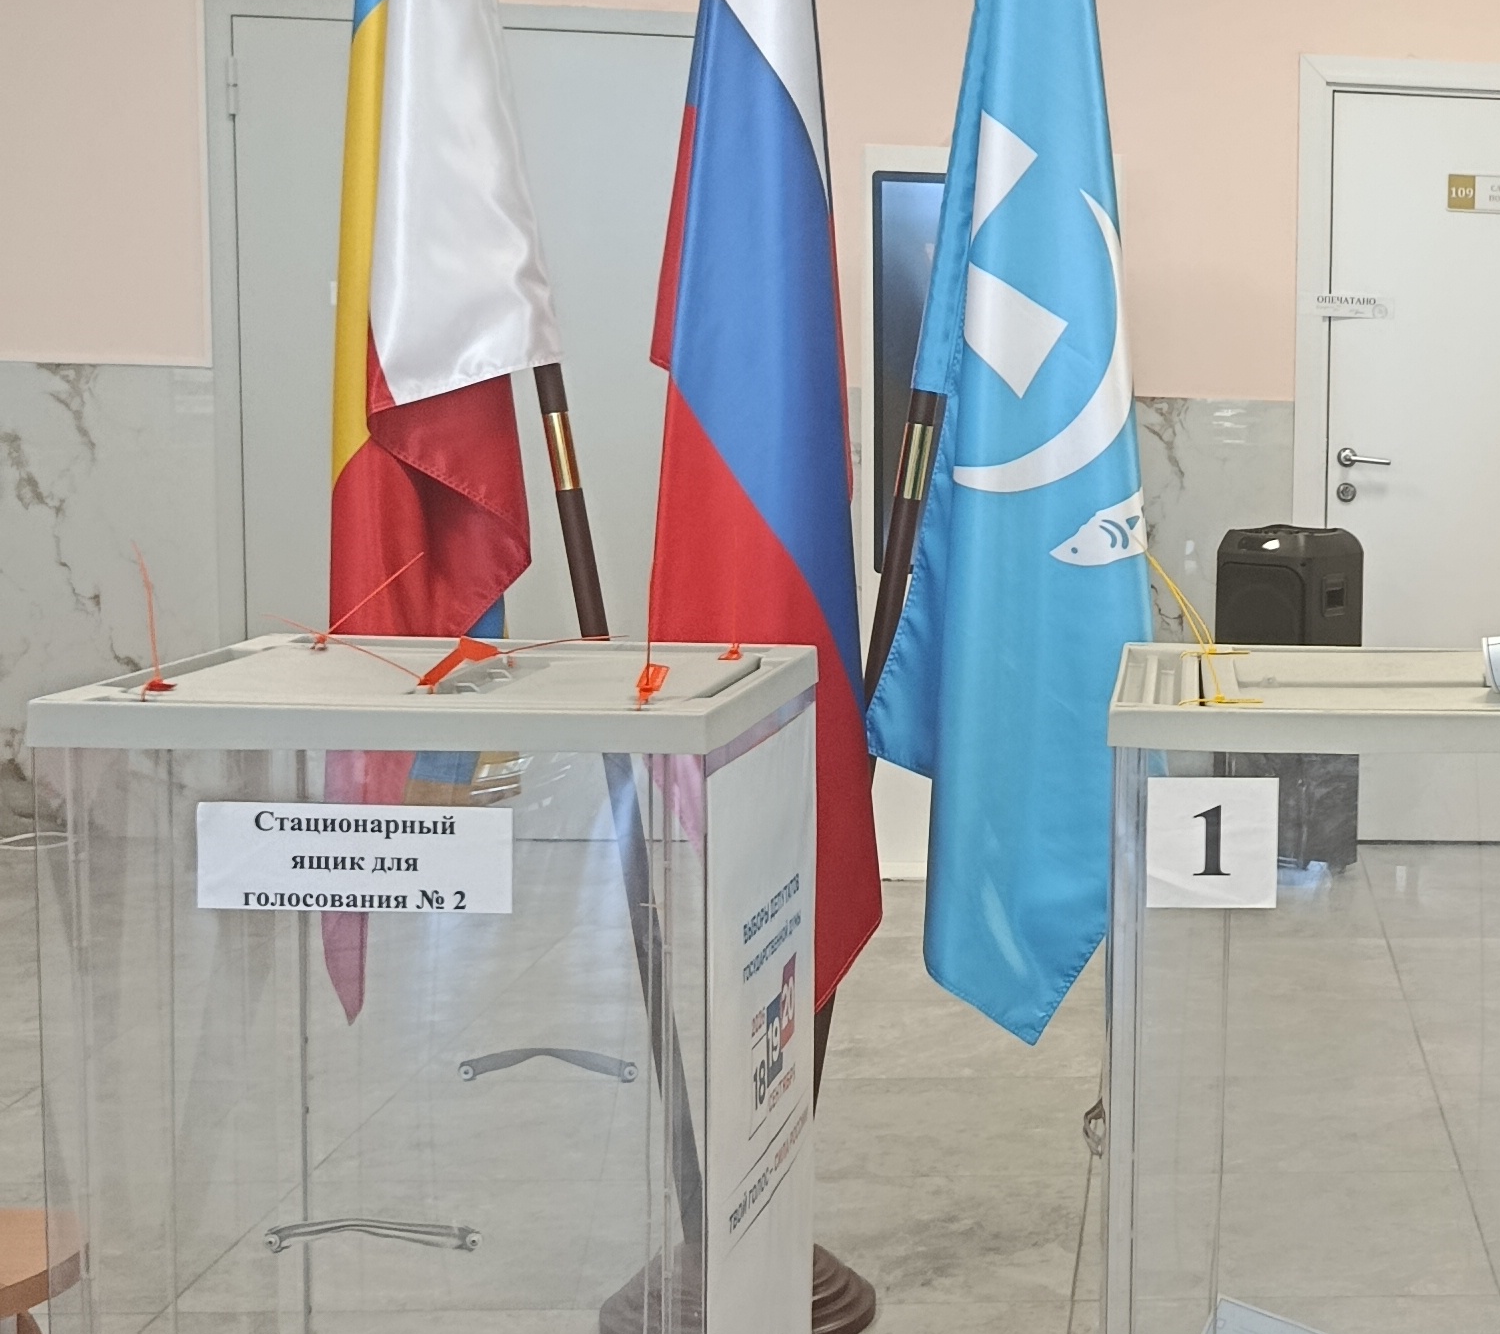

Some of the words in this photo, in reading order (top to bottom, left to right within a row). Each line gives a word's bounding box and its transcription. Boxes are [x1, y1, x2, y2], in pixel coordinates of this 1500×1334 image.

[1450, 187, 1474, 199] 109
[1316, 295, 1377, 306] ОПЕЧАТАНО
[254, 810, 456, 839] Стационарный
[1192, 804, 1232, 877] 1
[291, 854, 366, 872] ящик
[372, 856, 420, 873] для
[243, 891, 408, 910] голосования
[415, 889, 446, 910] №
[453, 890, 467, 910] 2
[743, 902, 769, 945] ВЫБОРЫ
[770, 872, 800, 921] ДЕПУТАТОВ
[753, 1059, 766, 1111] 18
[767, 1016, 781, 1068] 19
[781, 976, 795, 1030] 20
[729, 1191, 748, 1234] ТВОЙ
[748, 1166, 769, 1209] ГОЛОС
